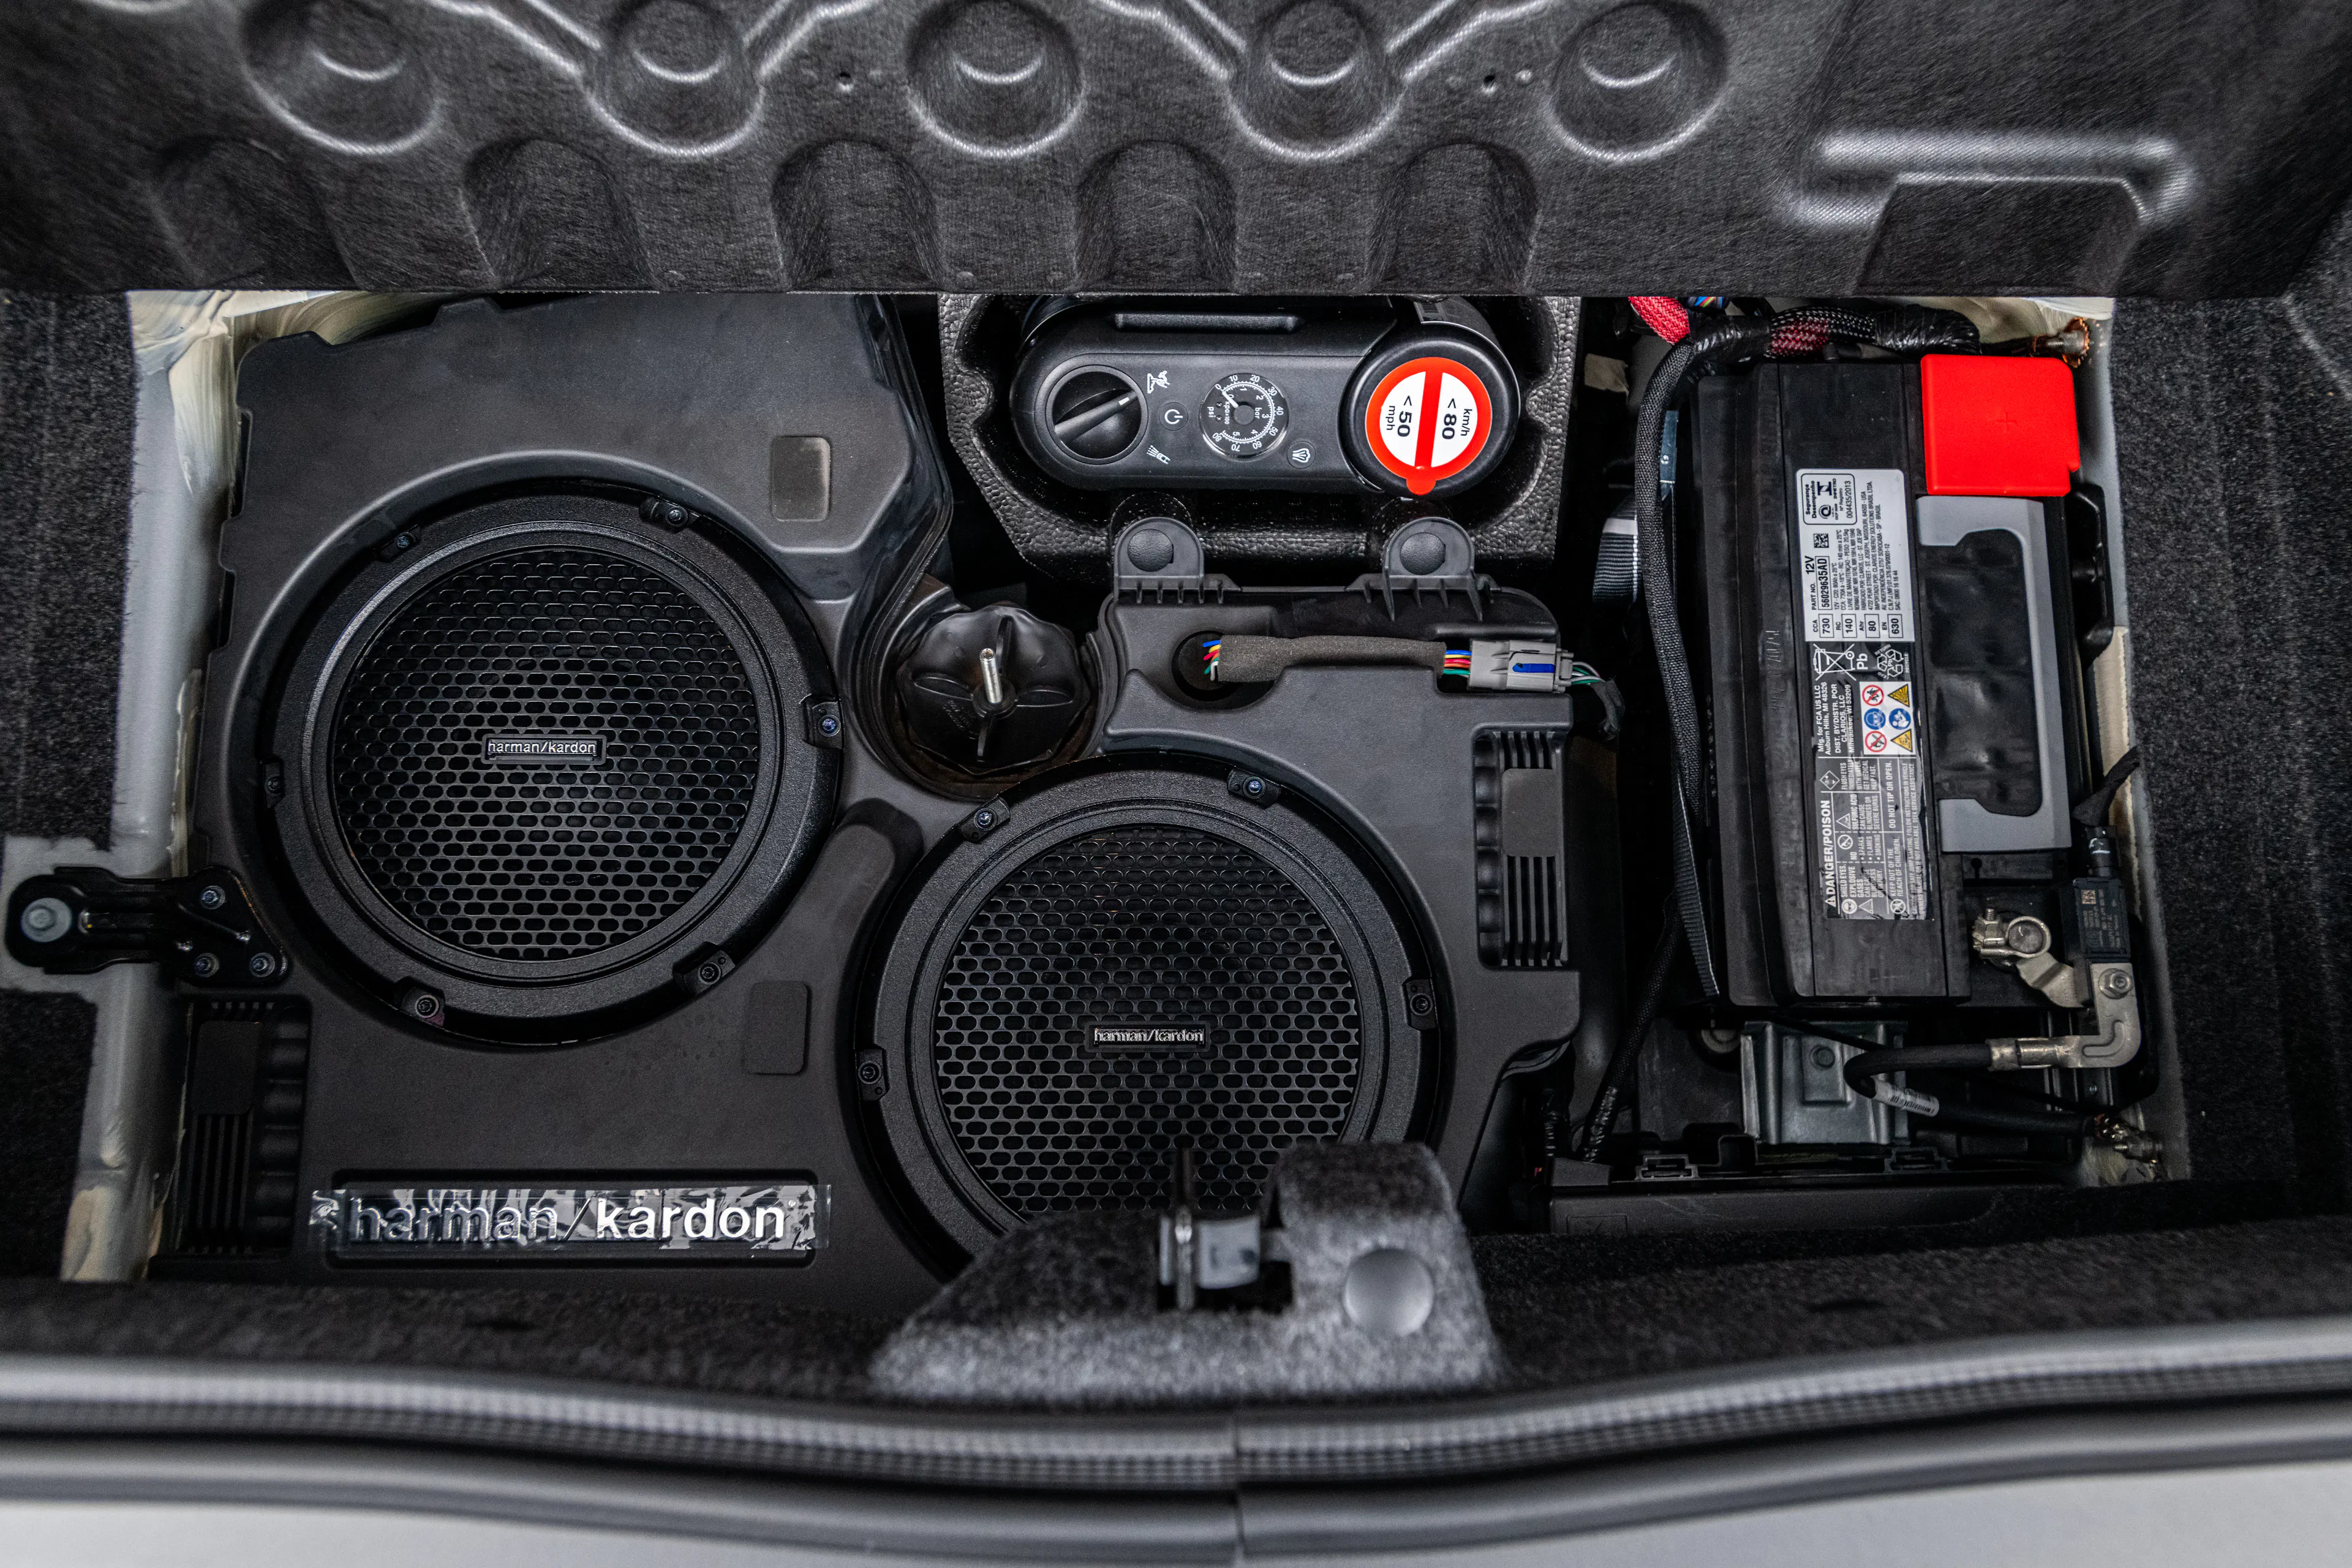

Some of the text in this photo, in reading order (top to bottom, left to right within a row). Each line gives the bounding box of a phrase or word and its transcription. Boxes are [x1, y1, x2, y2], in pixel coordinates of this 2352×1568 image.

[1268, 386, 1277, 396] 30
[1207, 407, 1216, 417] psi
[1276, 406, 1284, 415] 40
[1385, 405, 1395, 431] mph
[1461, 409, 1472, 436] km/h
[1269, 427, 1278, 436] 50
[1213, 432, 1222, 442] 80
[1844, 481, 1853, 518] 004435/2013
[1805, 556, 1815, 574] 12V
[1817, 559, 1830, 607] 56029635AD
[1836, 622, 1841, 630] RC
[1868, 621, 1876, 631] 80
[1882, 622, 1887, 630] EN
[1891, 618, 1899, 634] 630
[1856, 654, 1868, 670] Pb
[1815, 700, 1821, 709] US
[1846, 705, 1852, 714] WI
[488, 740, 596, 753] harman/kardon
[1886, 782, 1893, 791] OR
[1888, 819, 1896, 828] DO
[1820, 800, 1836, 895] DANGER/POISON
[1850, 851, 1857, 860] NO
[1848, 866, 1857, 897] EXPLOSIVE
[1094, 1029, 1204, 1041] harman/kardon
